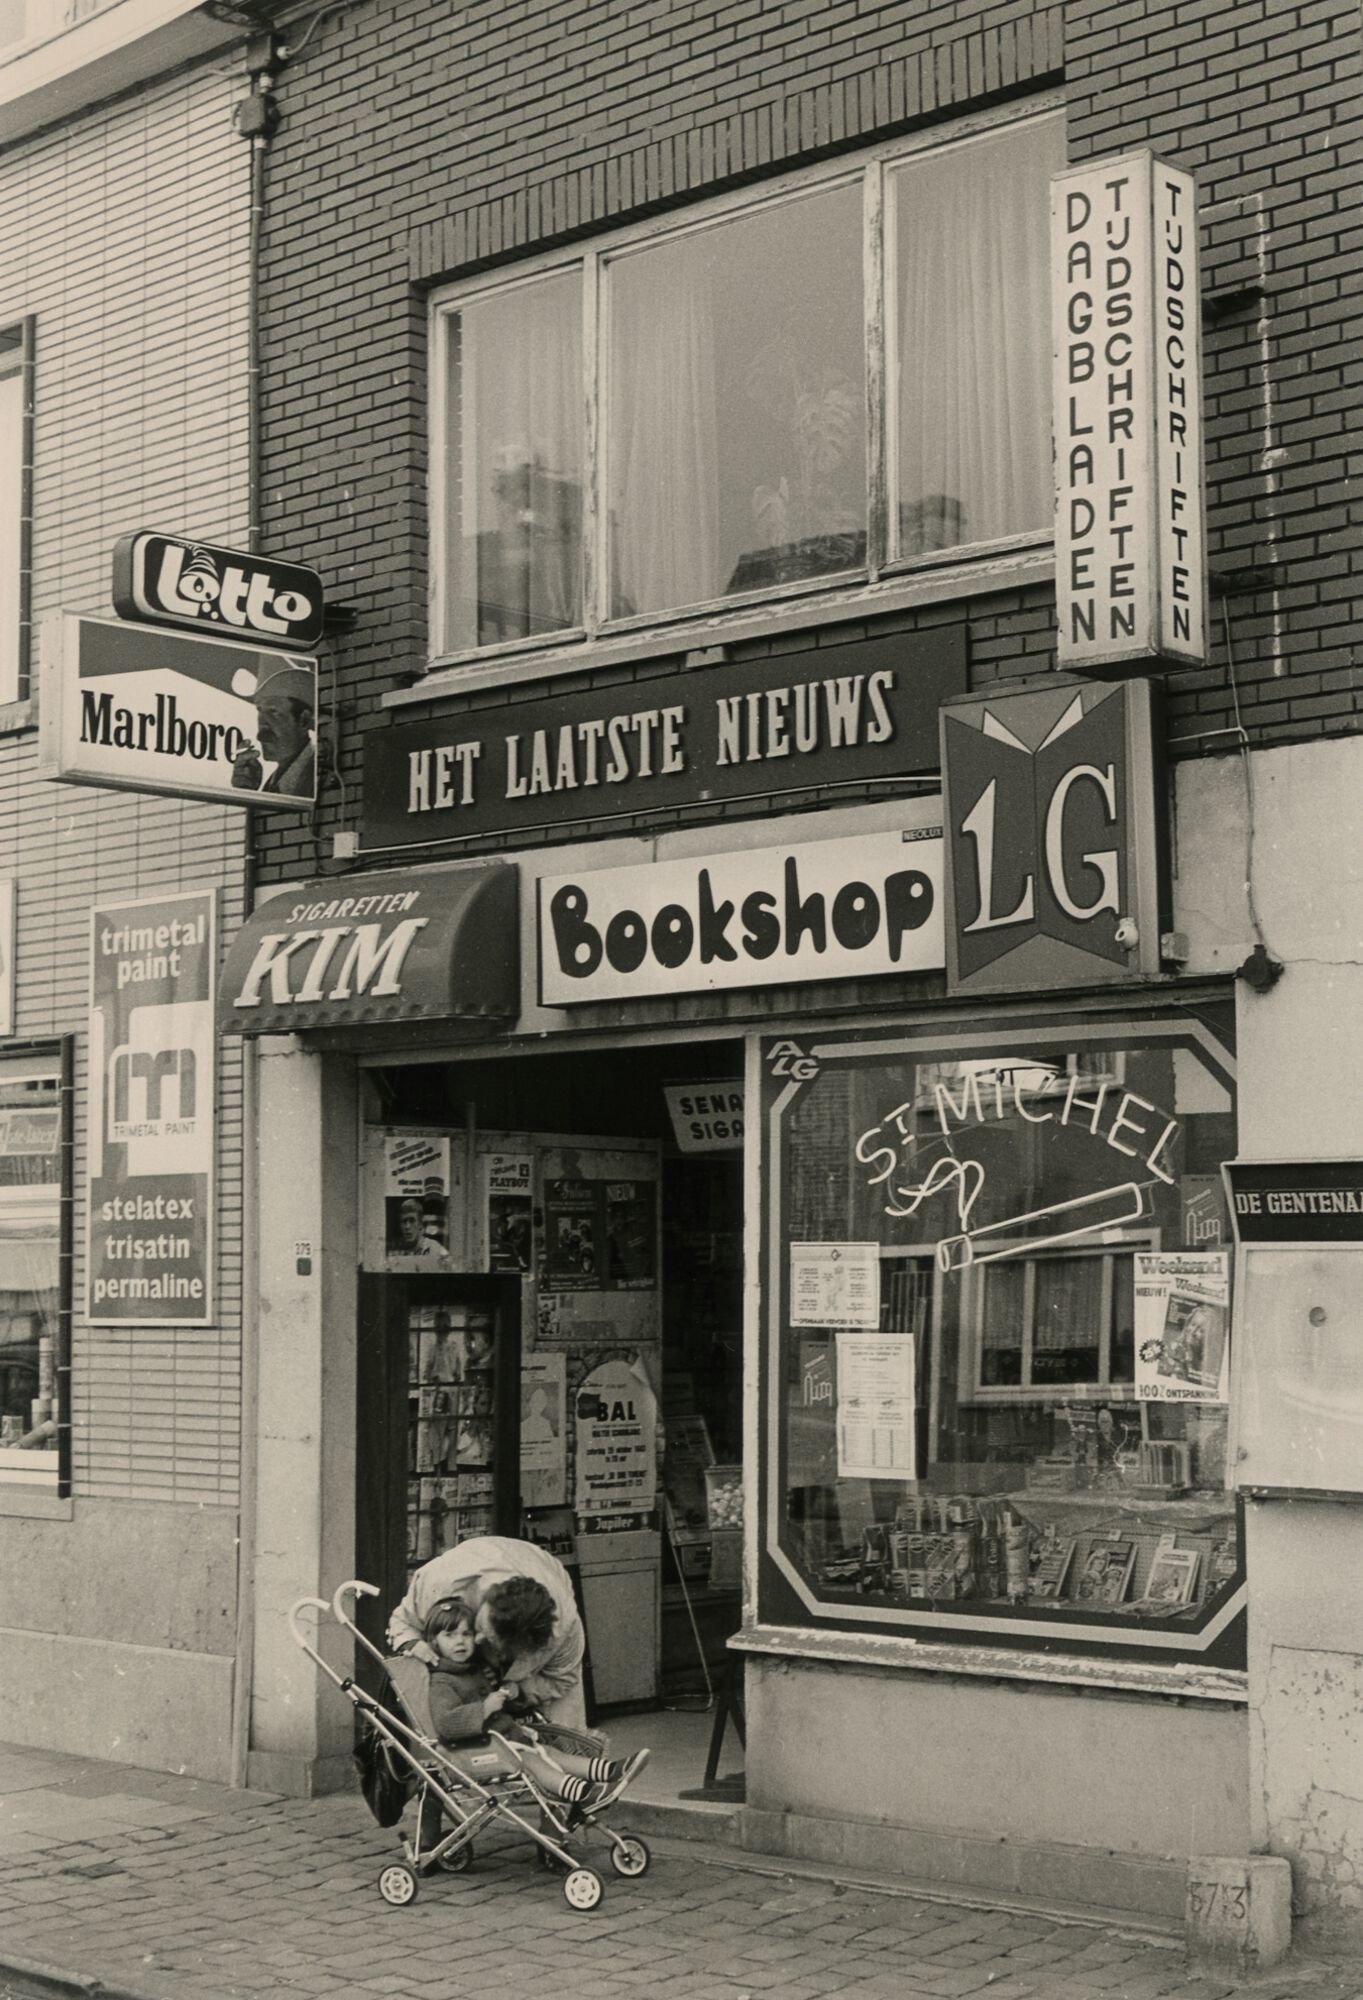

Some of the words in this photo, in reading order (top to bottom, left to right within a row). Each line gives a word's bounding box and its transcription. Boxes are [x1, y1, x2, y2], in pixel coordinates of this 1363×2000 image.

[1066, 191, 1096, 644] DAGBLADEN
[80, 689, 243, 764] Marlboro
[407, 741, 481, 814] HET
[504, 705, 686, 799] LAATSTE
[716, 670, 894, 767] NIEUWS
[904, 827, 942, 841] NEOLUX
[961, 762, 1120, 934] LG
[286, 890, 421, 925] SIGARETTEN
[549, 856, 935, 979] Bookshop
[101, 914, 205, 955] trimetal
[117, 949, 181, 989] paint
[233, 917, 428, 1008] KIM
[680, 1092, 745, 1116] SENA
[114, 1124, 159, 1138] TRIMETAL
[165, 1121, 196, 1135] PAINT
[935, 1072, 1176, 1186] MICHEL
[102, 1195, 194, 1221] stelatex
[1235, 1193, 1262, 1214] DE
[106, 1234, 190, 1259] trisatin
[94, 1273, 203, 1303] permaline
[597, 1401, 637, 1422] BAL
